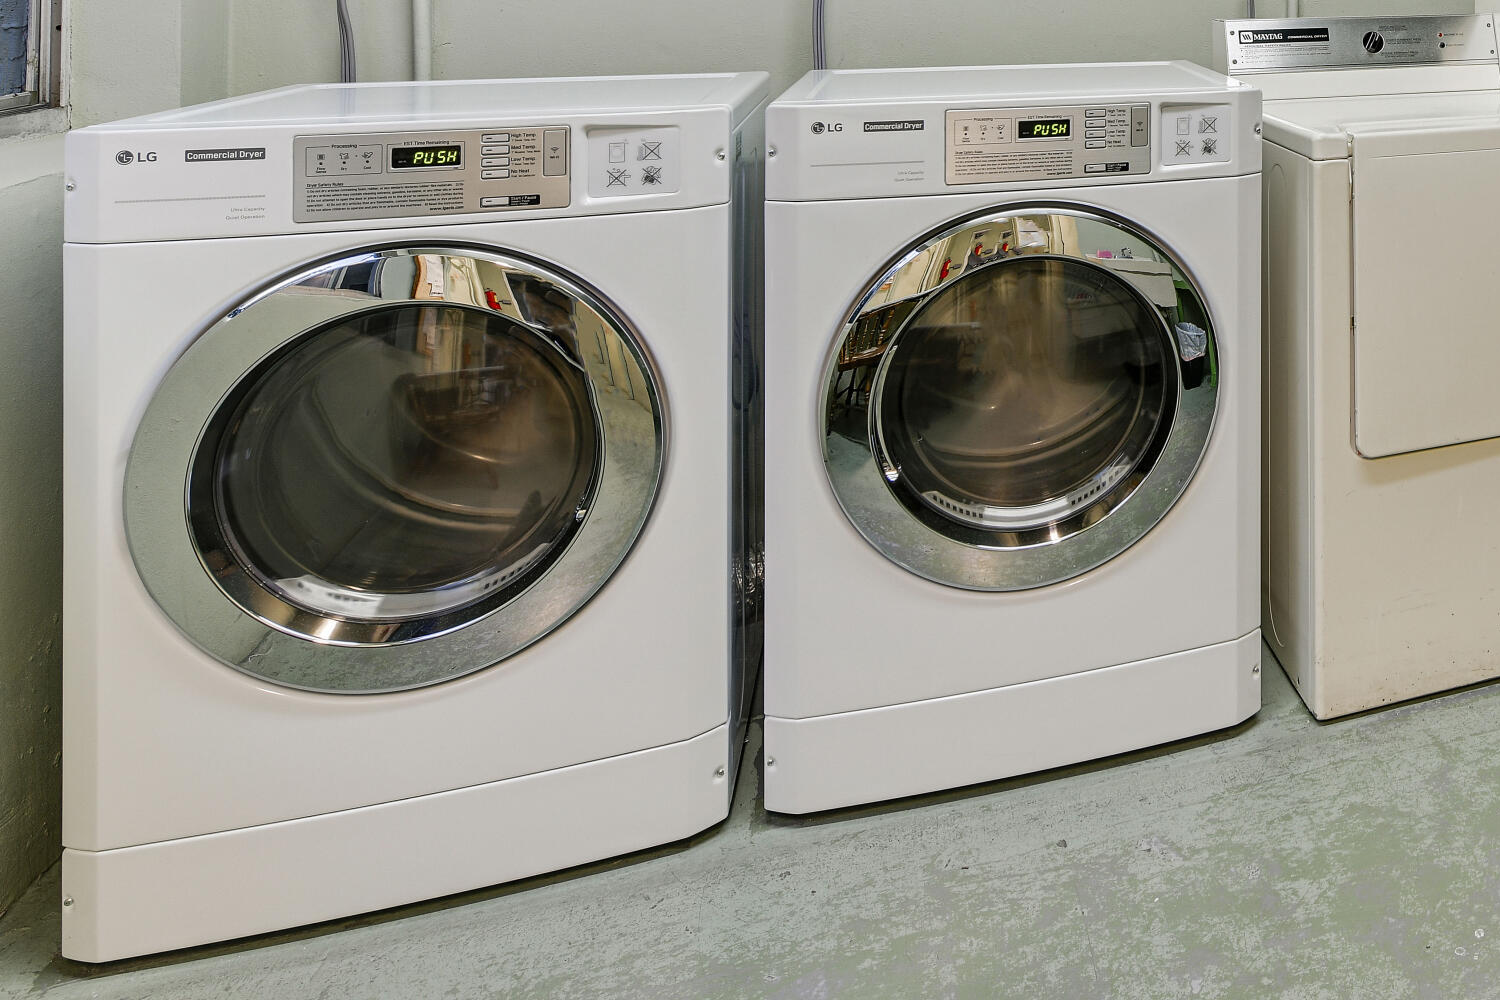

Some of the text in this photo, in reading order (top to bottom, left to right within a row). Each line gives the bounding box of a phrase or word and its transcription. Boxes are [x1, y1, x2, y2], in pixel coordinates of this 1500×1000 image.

[828, 123, 842, 132] LG
[865, 122, 923, 131] Commercial Dryer
[1034, 124, 1067, 135] PUSH
[138, 152, 157, 162] LG
[187, 150, 263, 160] Commercial Dryer
[413, 151, 457, 164] PUSH
